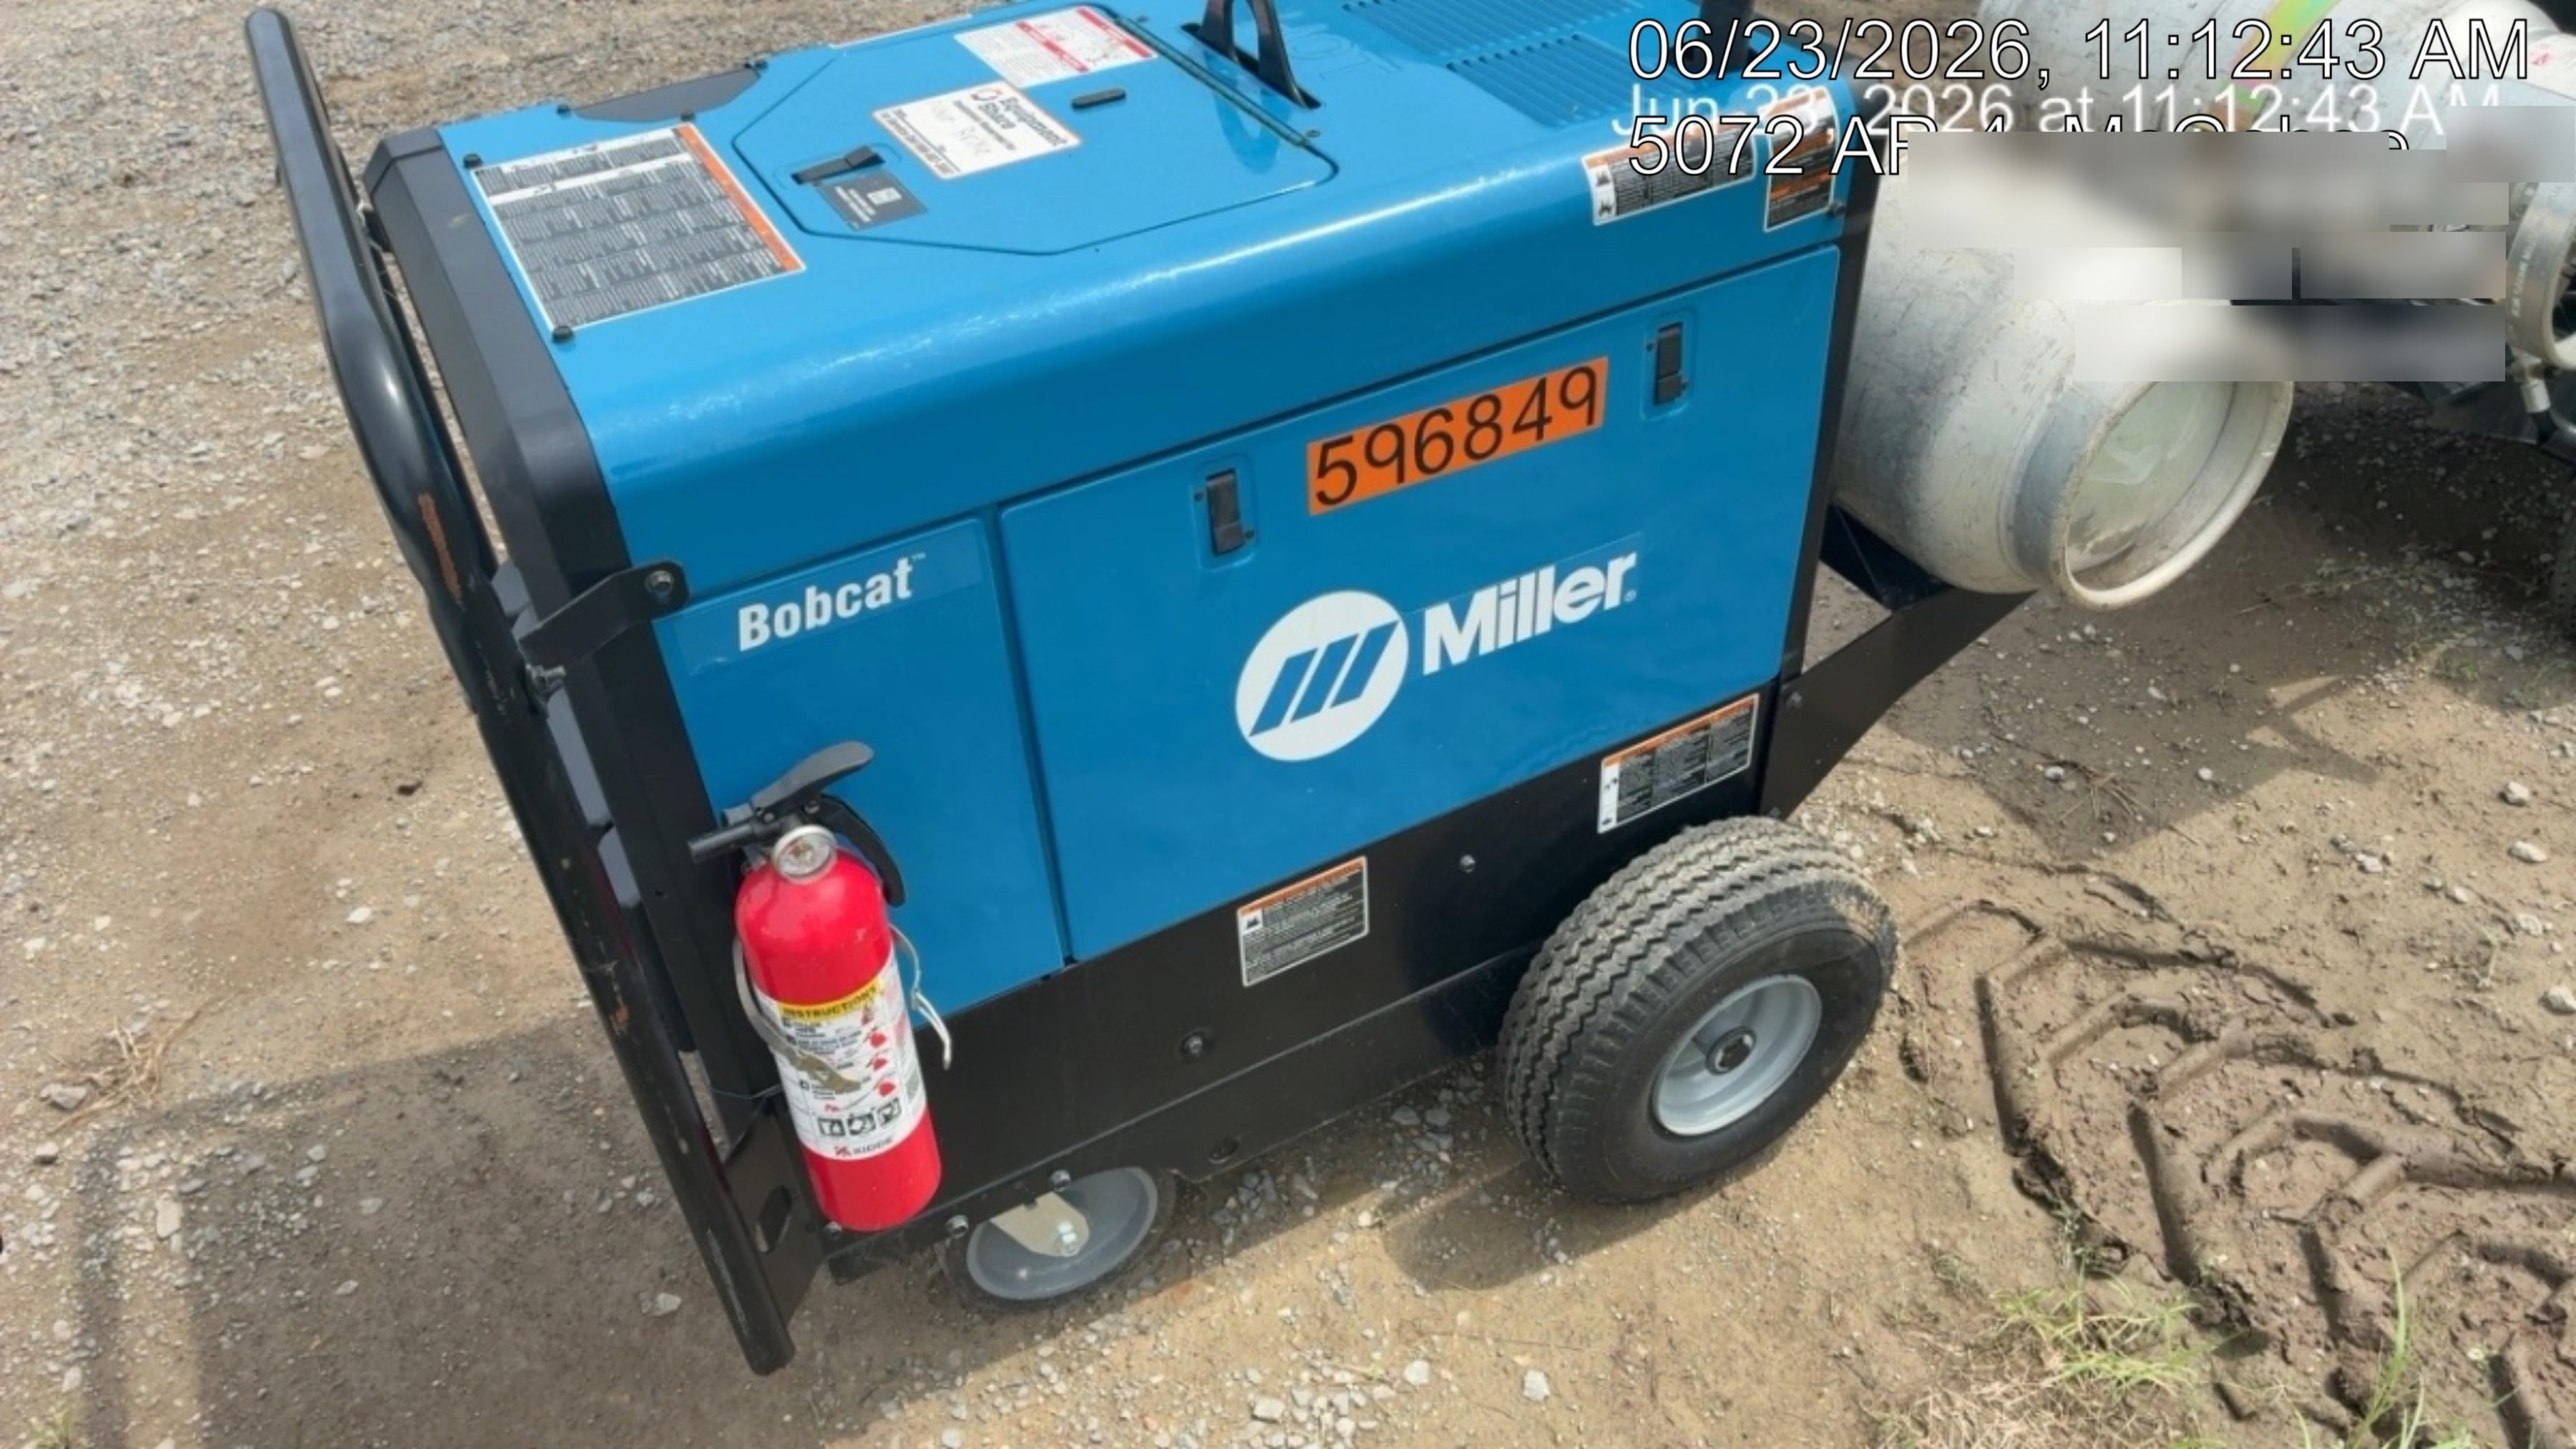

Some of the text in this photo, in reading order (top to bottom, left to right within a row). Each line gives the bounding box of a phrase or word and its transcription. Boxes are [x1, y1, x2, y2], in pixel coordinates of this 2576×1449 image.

[1316, 365, 1597, 506] 596849
[738, 557, 914, 653] Bobcat
[1423, 551, 1637, 676] Miller
